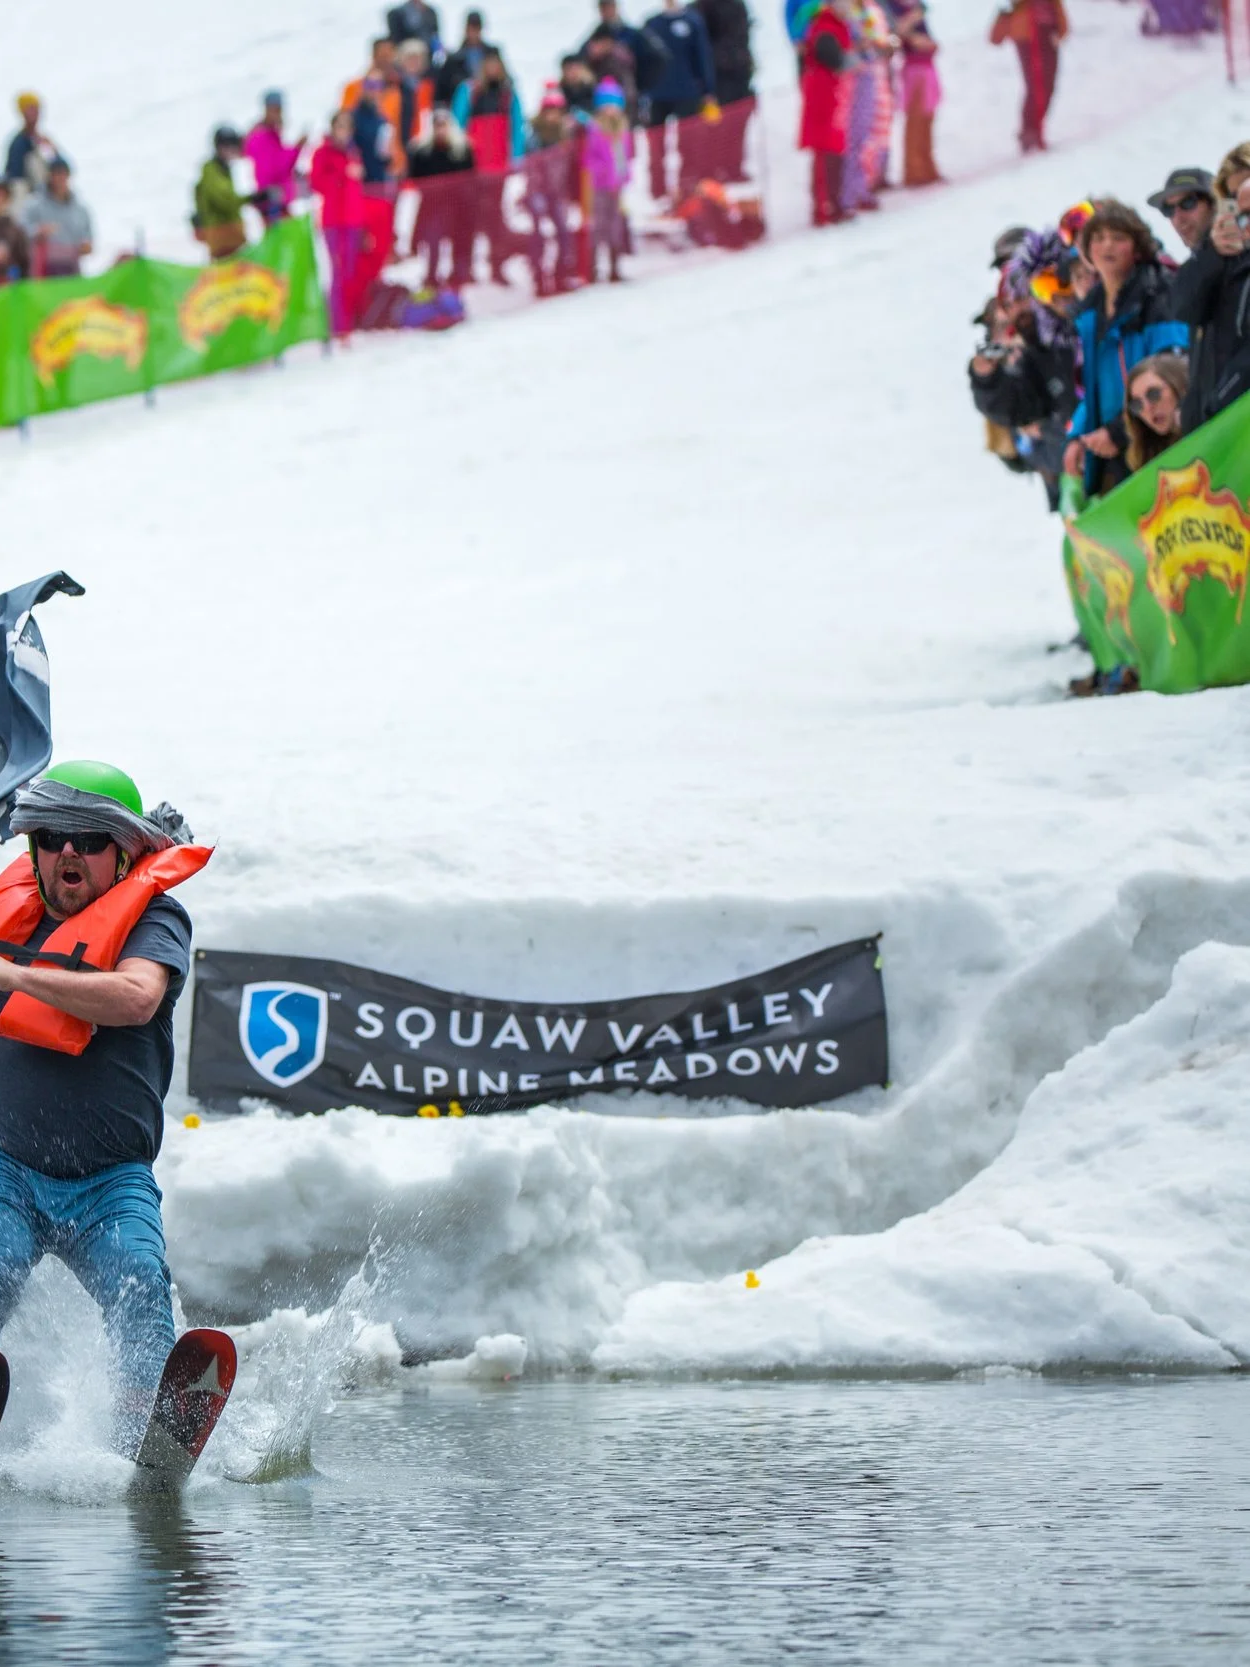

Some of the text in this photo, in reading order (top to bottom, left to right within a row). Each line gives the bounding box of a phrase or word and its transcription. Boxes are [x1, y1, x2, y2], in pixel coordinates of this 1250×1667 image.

[354, 982, 834, 1054] SQUAW VALLEY
[354, 1039, 840, 1097] ALPINE MEADOWS
